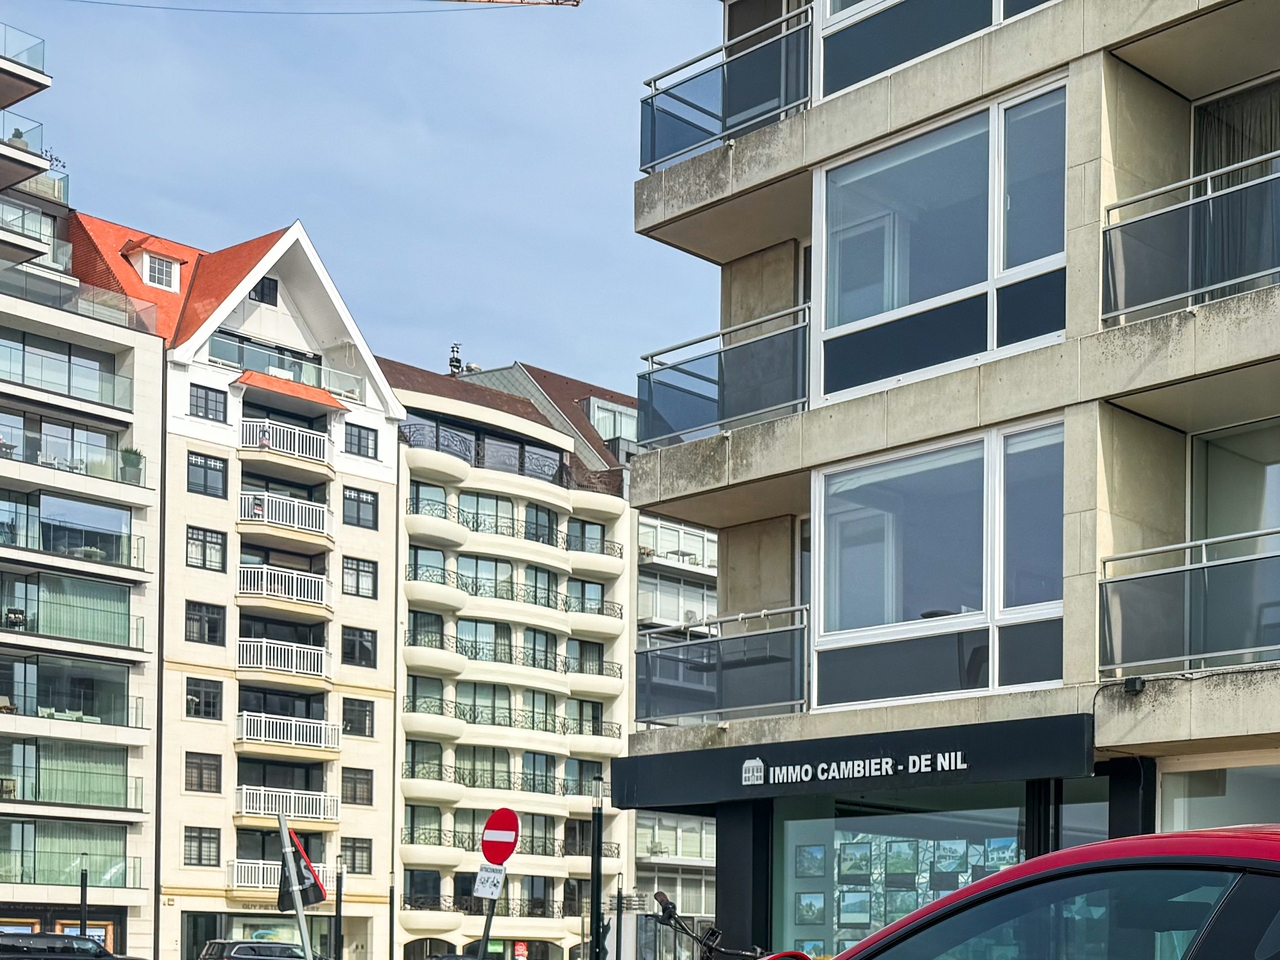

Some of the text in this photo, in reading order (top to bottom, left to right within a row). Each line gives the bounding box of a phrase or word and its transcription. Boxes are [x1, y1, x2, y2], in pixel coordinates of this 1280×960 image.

[769, 764, 813, 784] IMMO
[817, 758, 893, 780] CAMBIER
[908, 754, 932, 773] DE
[936, 751, 968, 772] NIL
